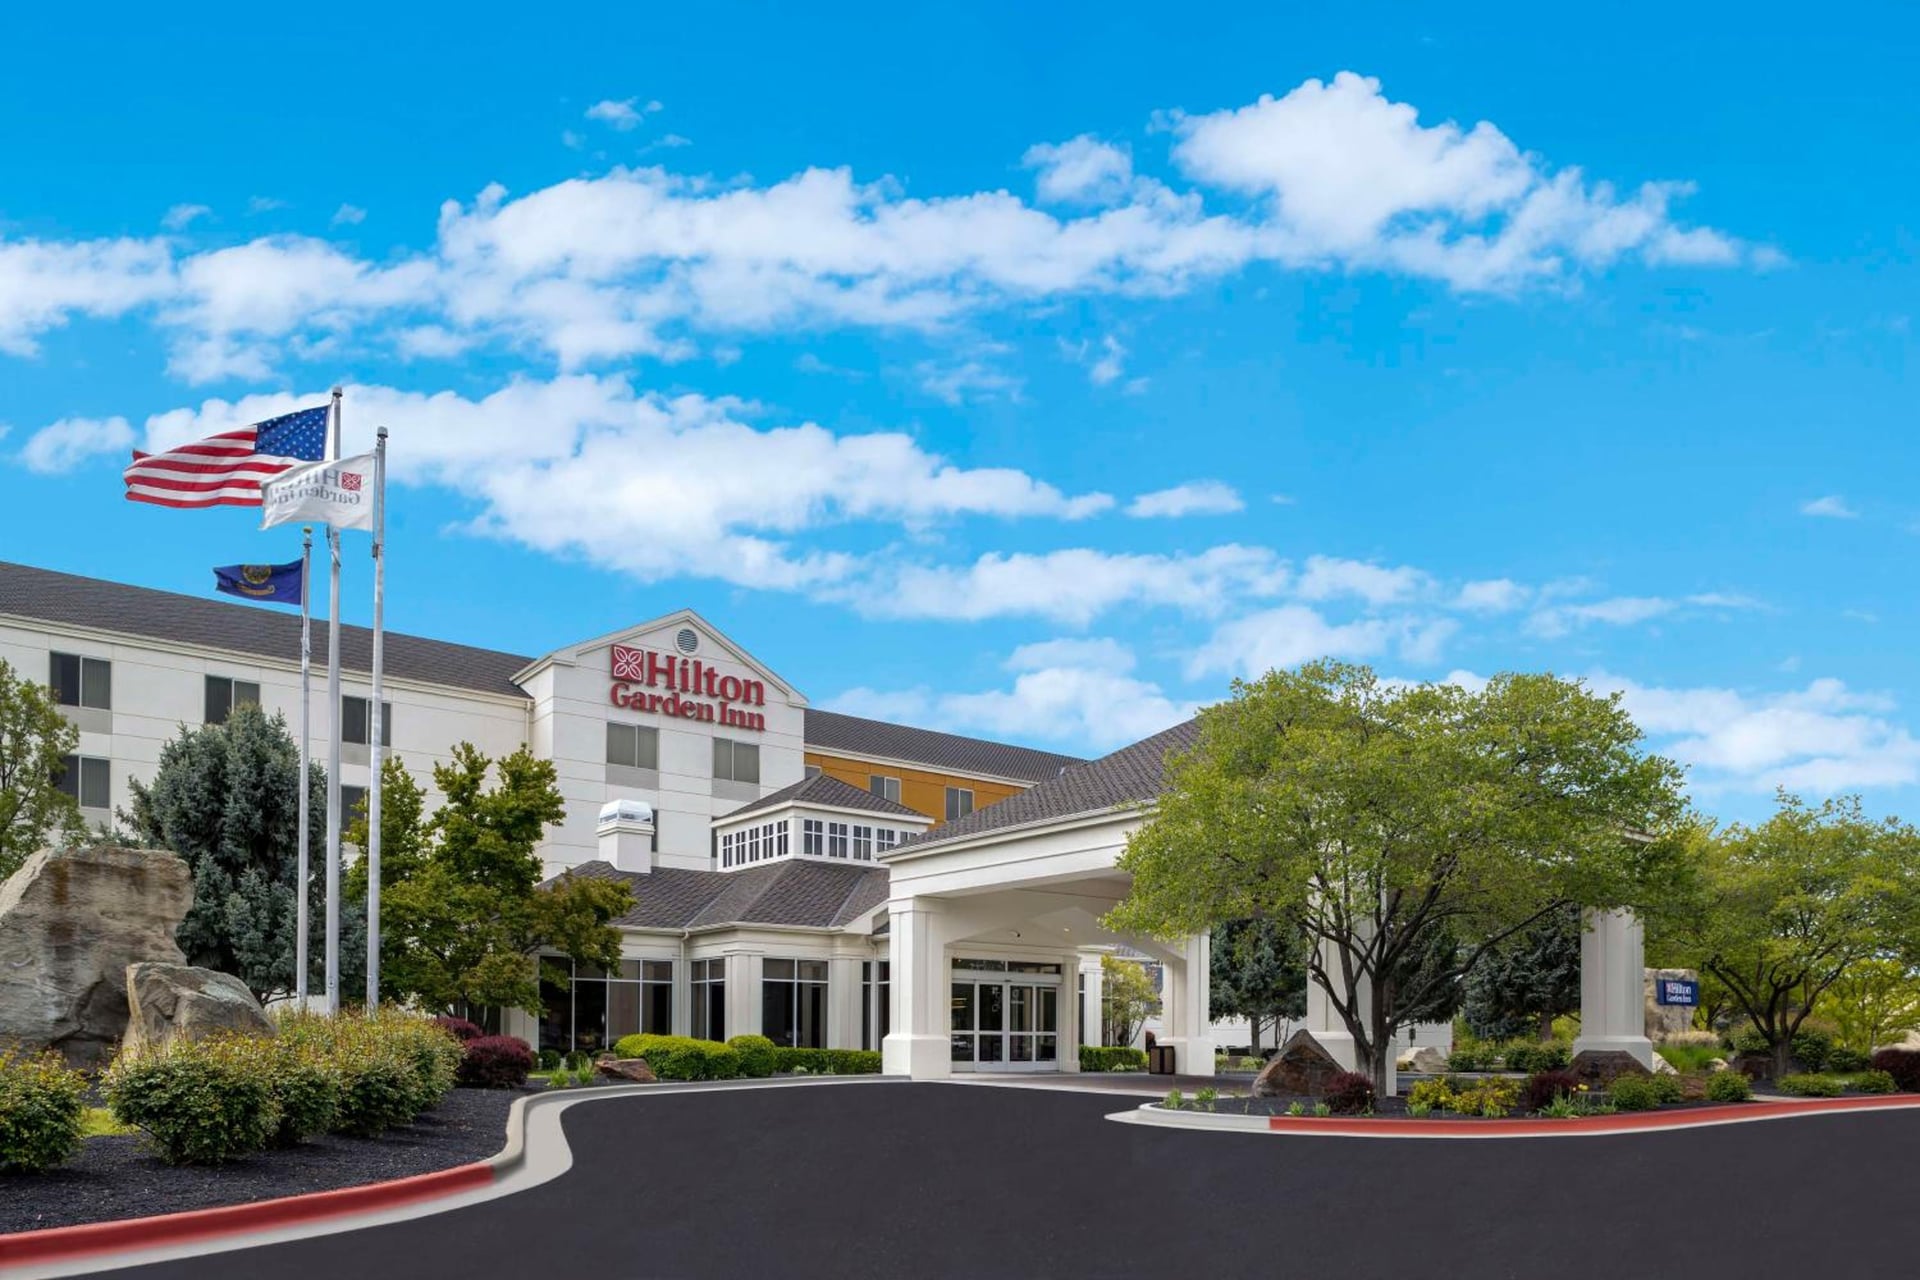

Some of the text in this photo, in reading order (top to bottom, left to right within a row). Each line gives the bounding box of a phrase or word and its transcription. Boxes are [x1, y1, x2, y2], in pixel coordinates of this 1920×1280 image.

[646, 651, 765, 706] Hilton
[610, 682, 766, 731] Garden Inn
[1672, 982, 1692, 995] Hilton
